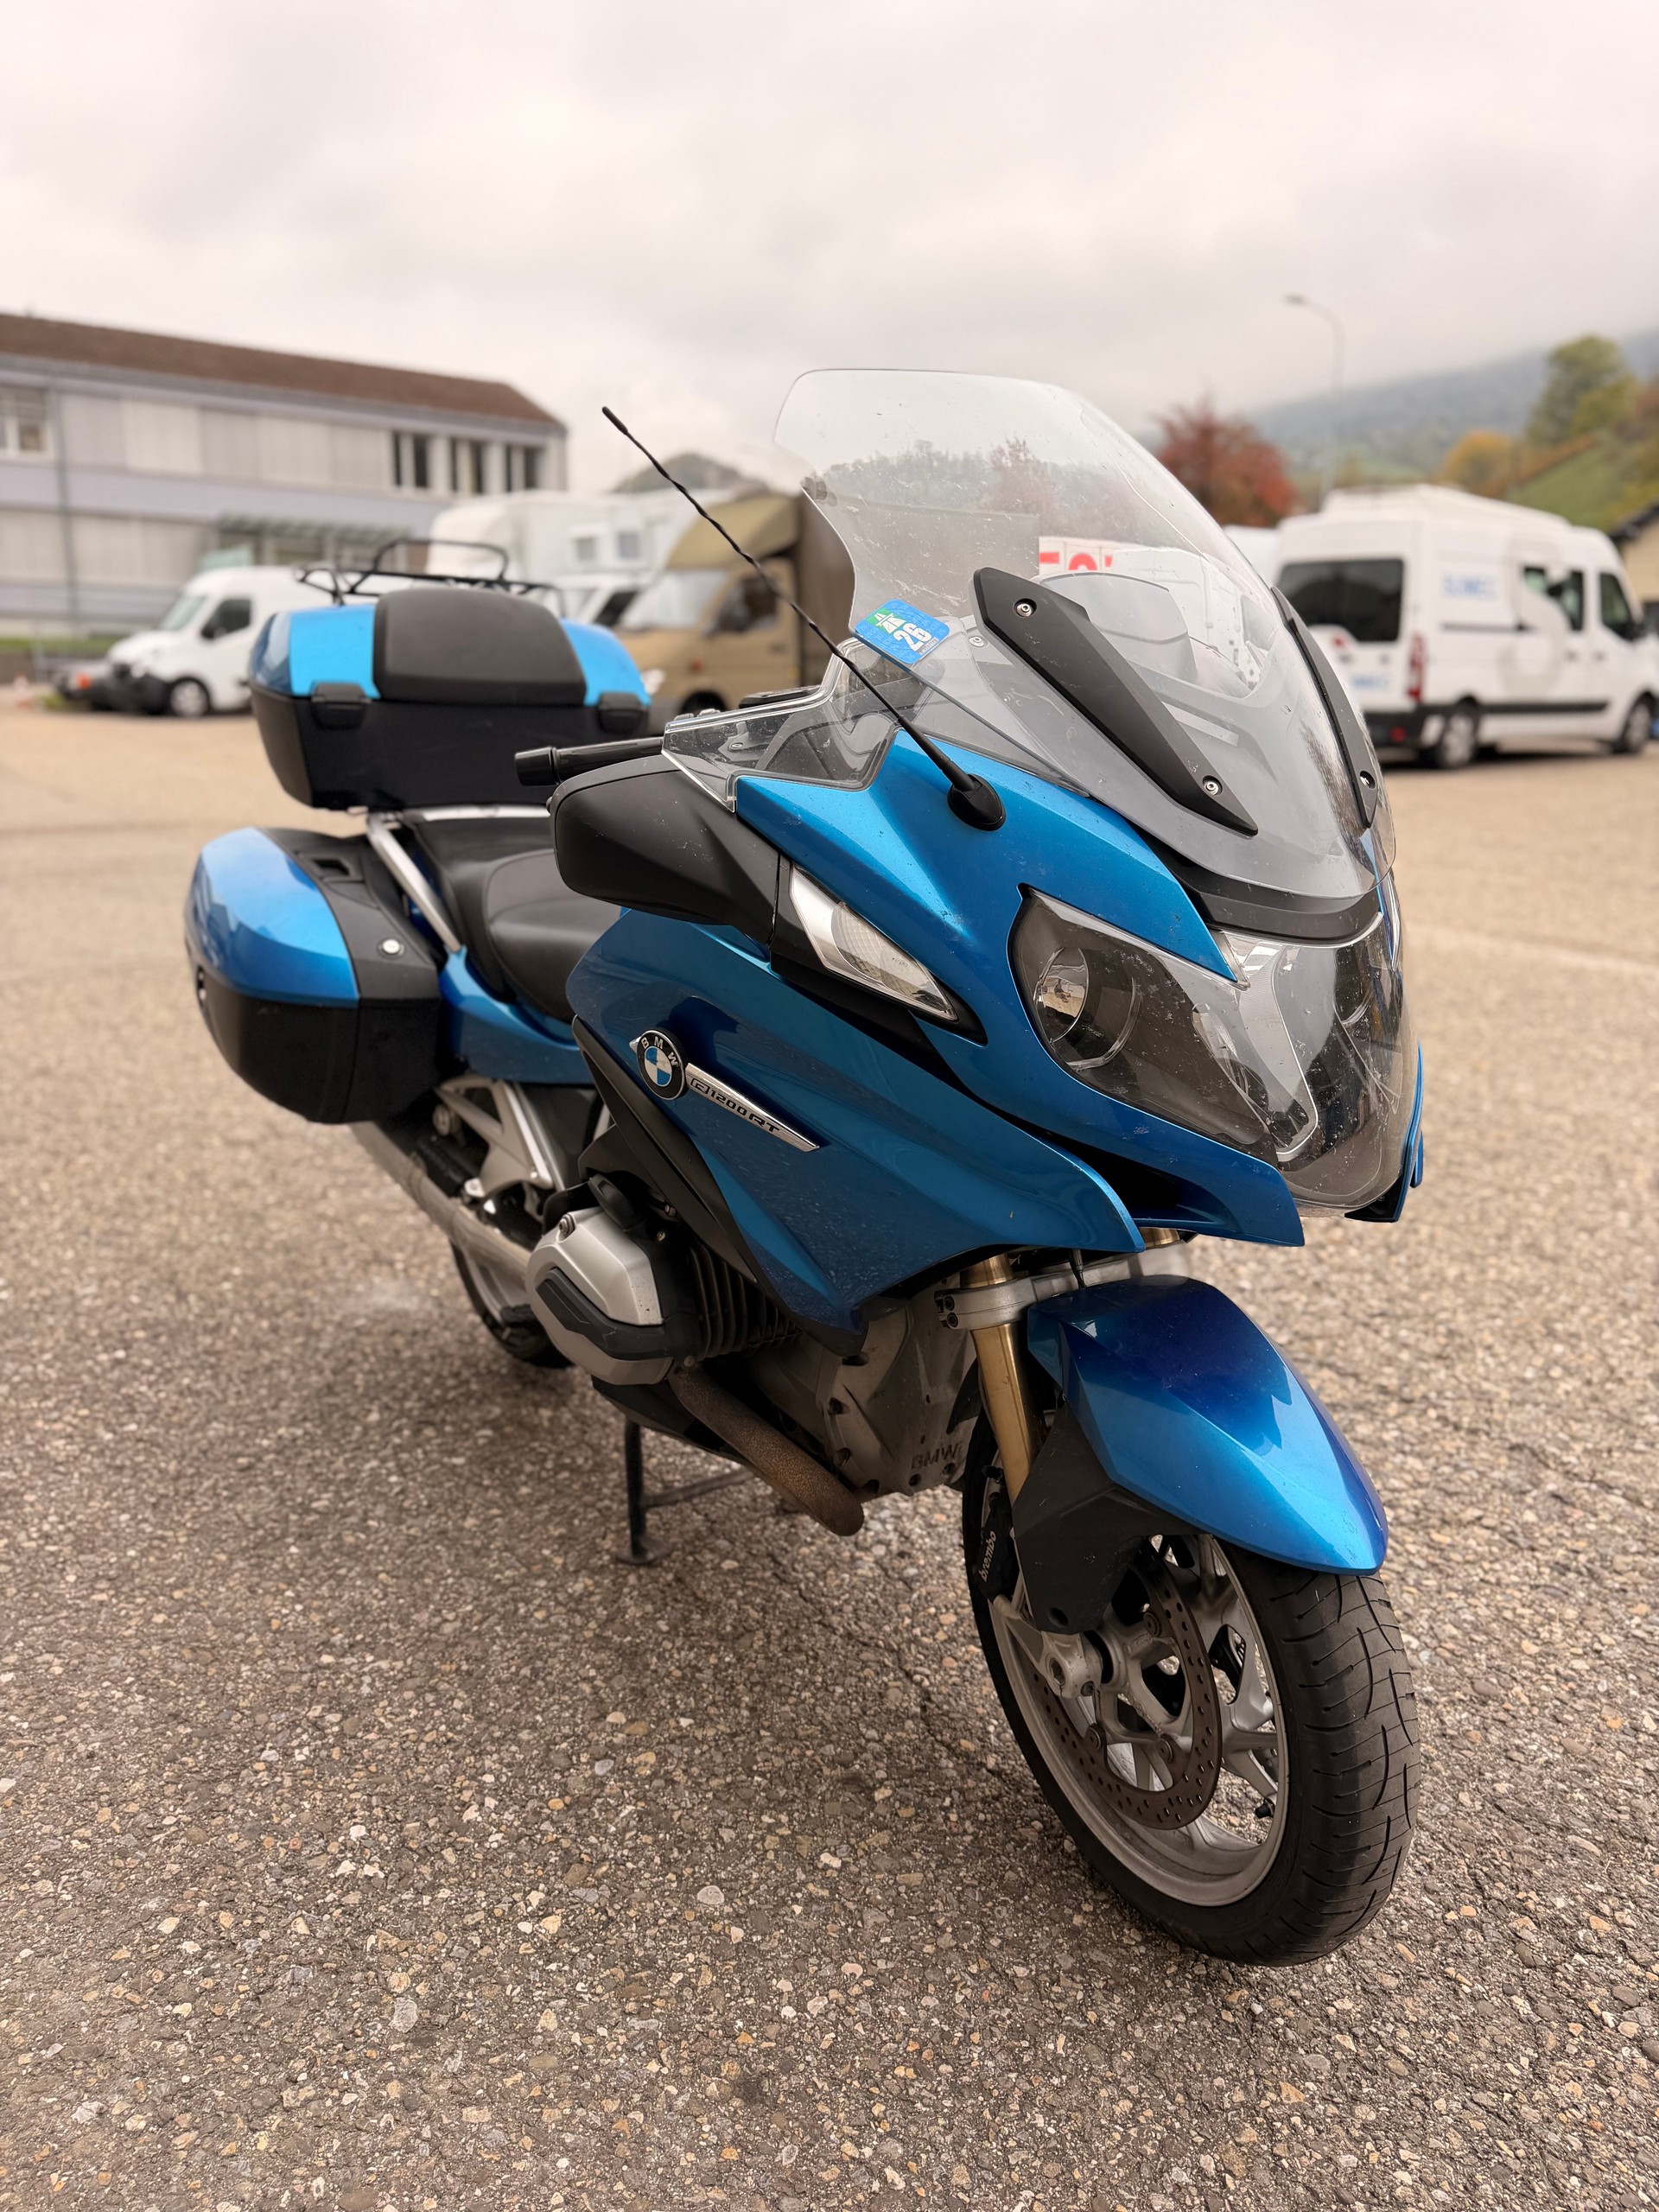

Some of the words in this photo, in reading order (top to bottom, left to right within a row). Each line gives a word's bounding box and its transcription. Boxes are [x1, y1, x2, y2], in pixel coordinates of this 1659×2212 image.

[893, 622, 932, 652] 26
[640, 1036, 679, 1066] BMW
[978, 1530, 997, 1582] brembo
